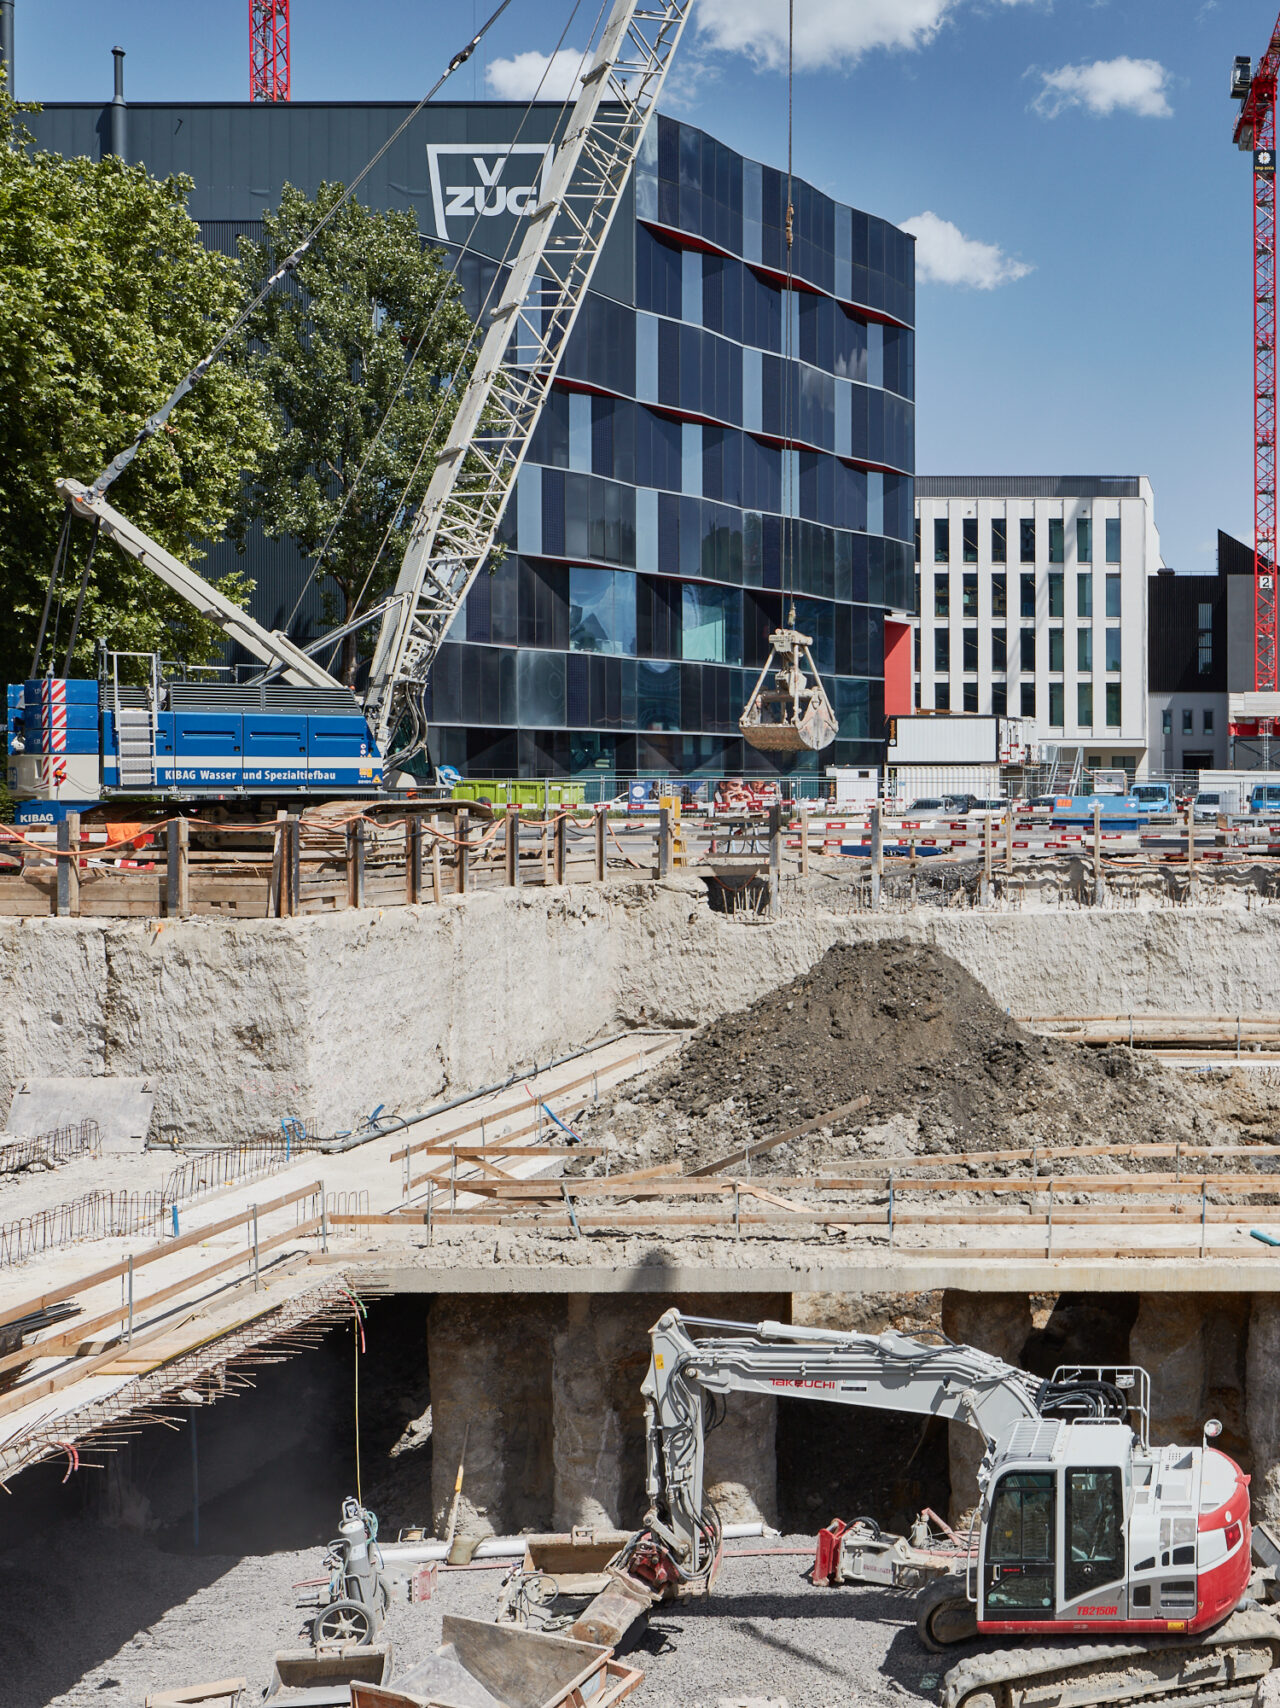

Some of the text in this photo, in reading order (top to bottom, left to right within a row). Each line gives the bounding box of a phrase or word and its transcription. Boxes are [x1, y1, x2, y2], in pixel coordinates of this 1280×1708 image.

[472, 157, 507, 186] V
[445, 186, 538, 217] ZUG
[1262, 577, 1270, 588] 2
[164, 769, 336, 781] KIBAG Wasser und Spezialtiefbau
[20, 813, 54, 823] KIBAG
[1076, 1606, 1119, 1616] TB2150R
